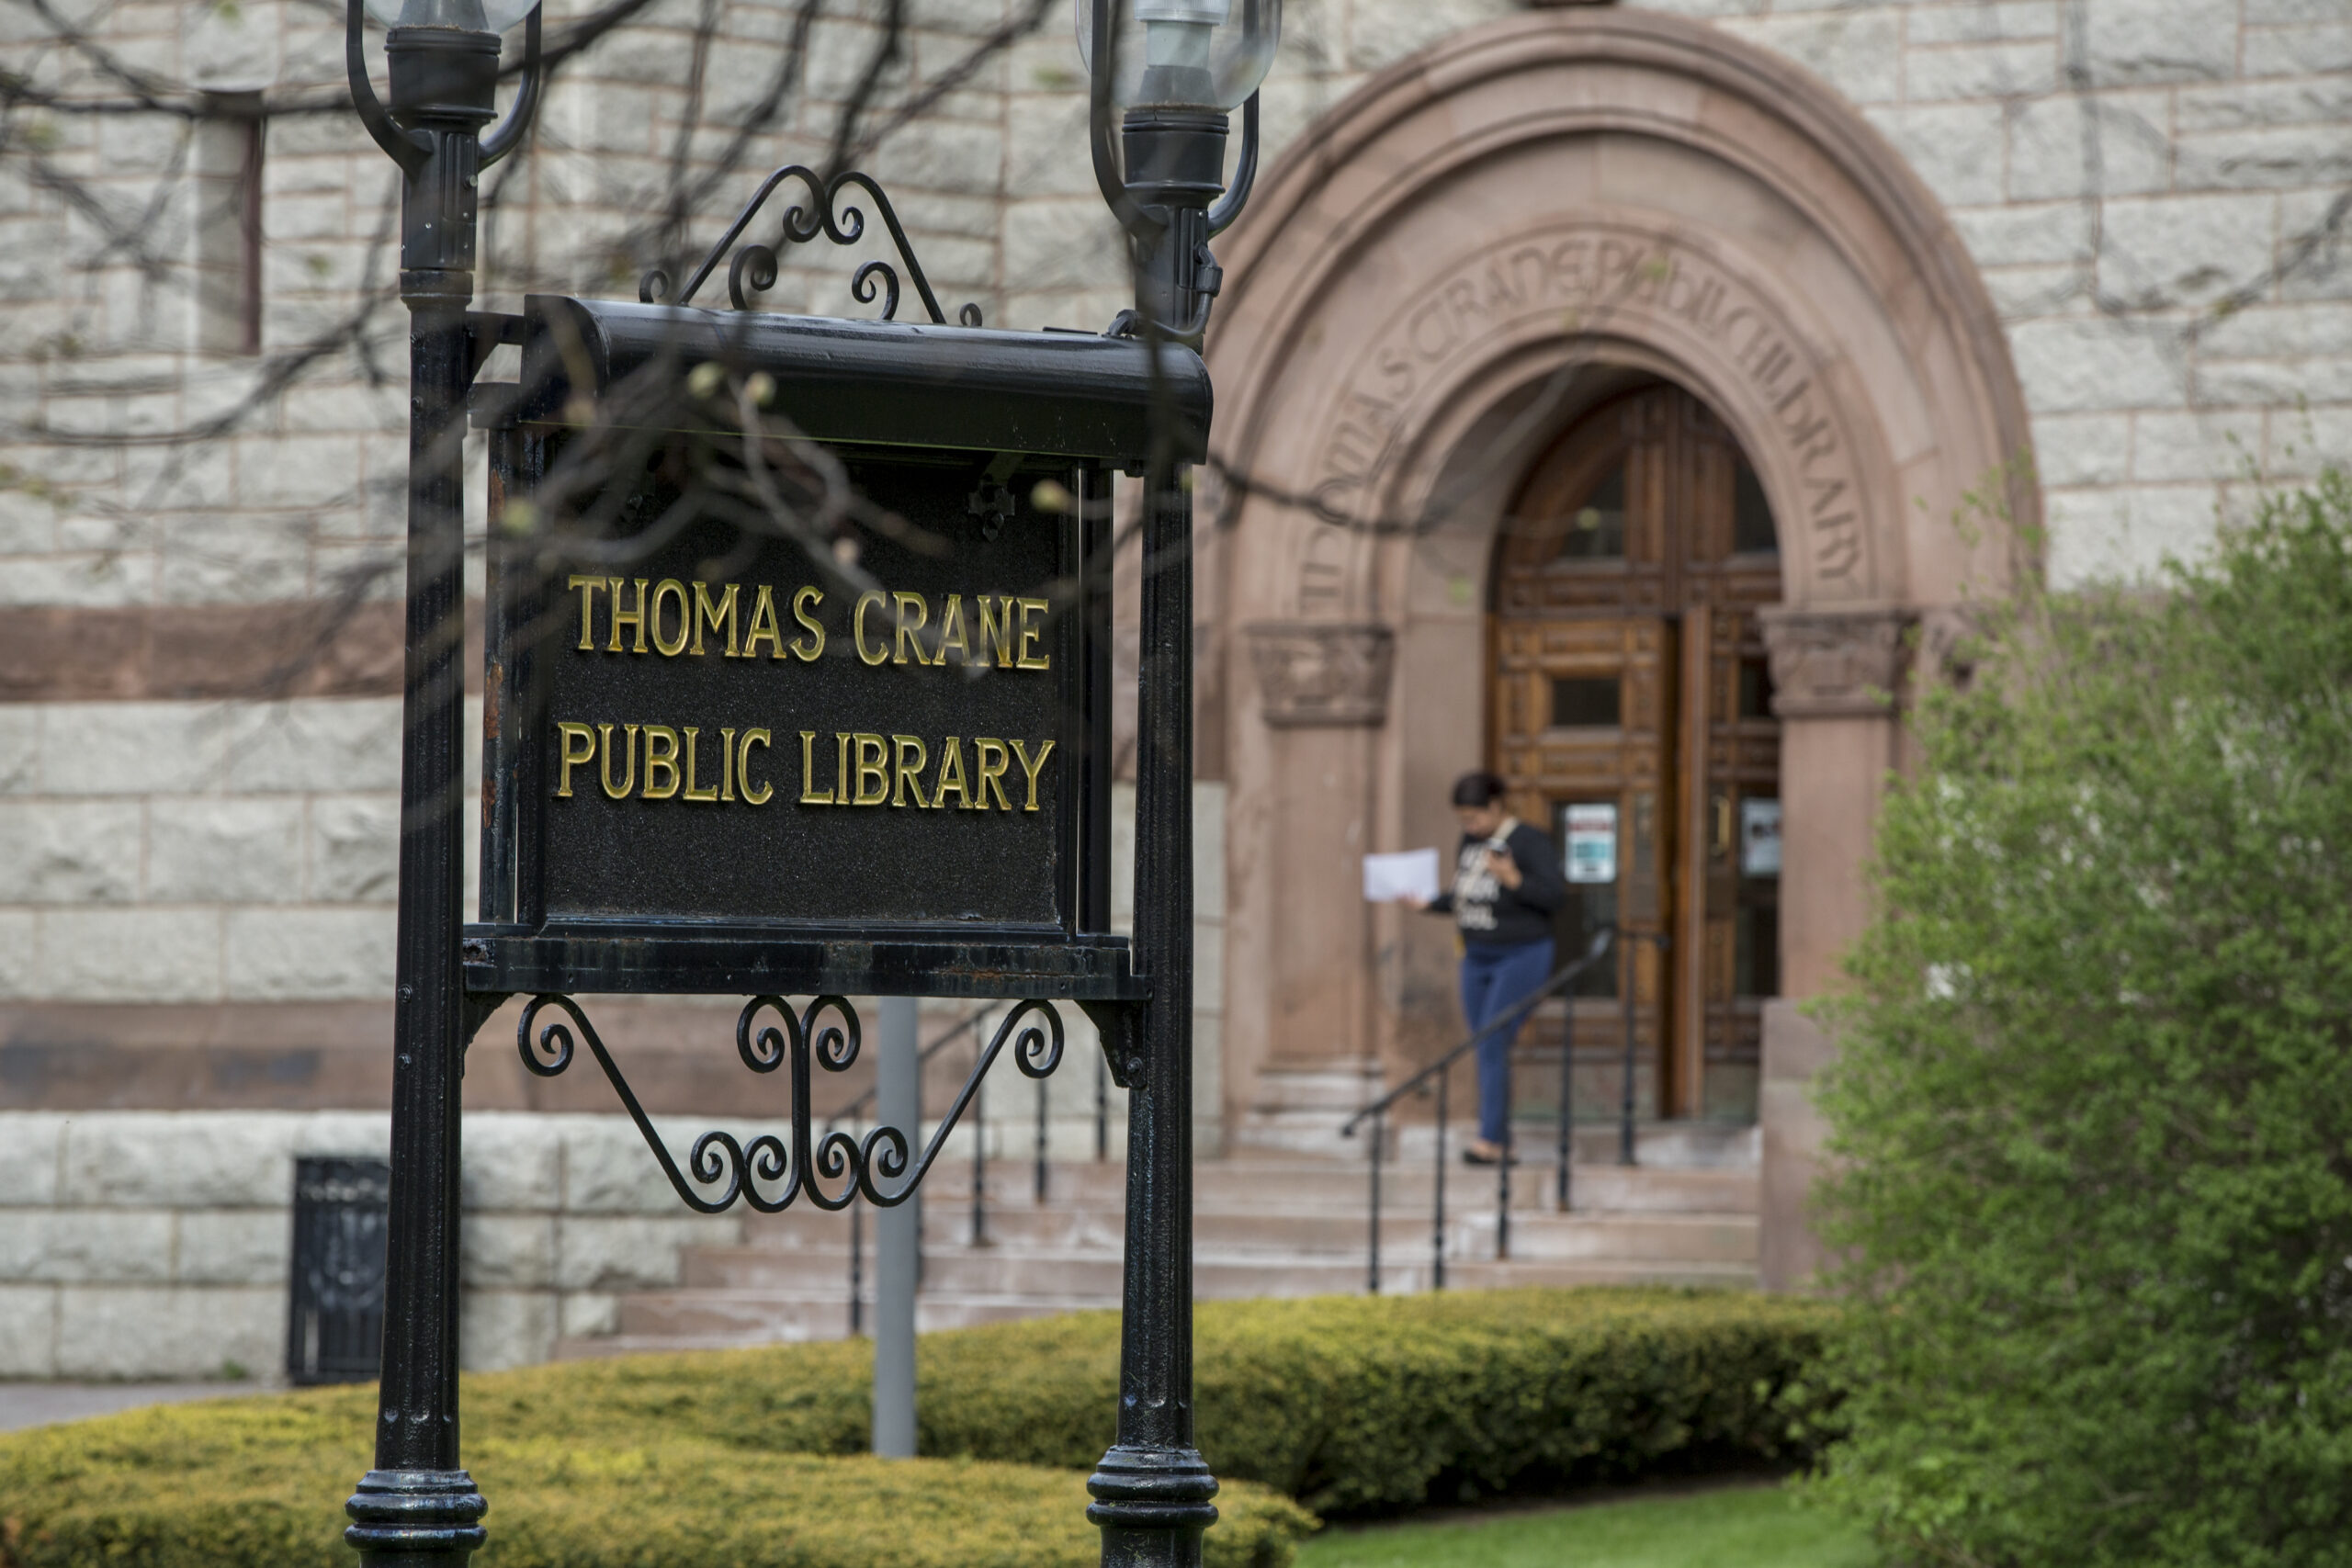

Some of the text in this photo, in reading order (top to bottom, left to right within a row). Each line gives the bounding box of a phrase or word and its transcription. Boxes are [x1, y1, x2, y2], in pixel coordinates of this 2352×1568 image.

[569, 575, 1050, 670] THOMAS CRANE
[558, 722, 1055, 811] PUBLIC LIBRARY
